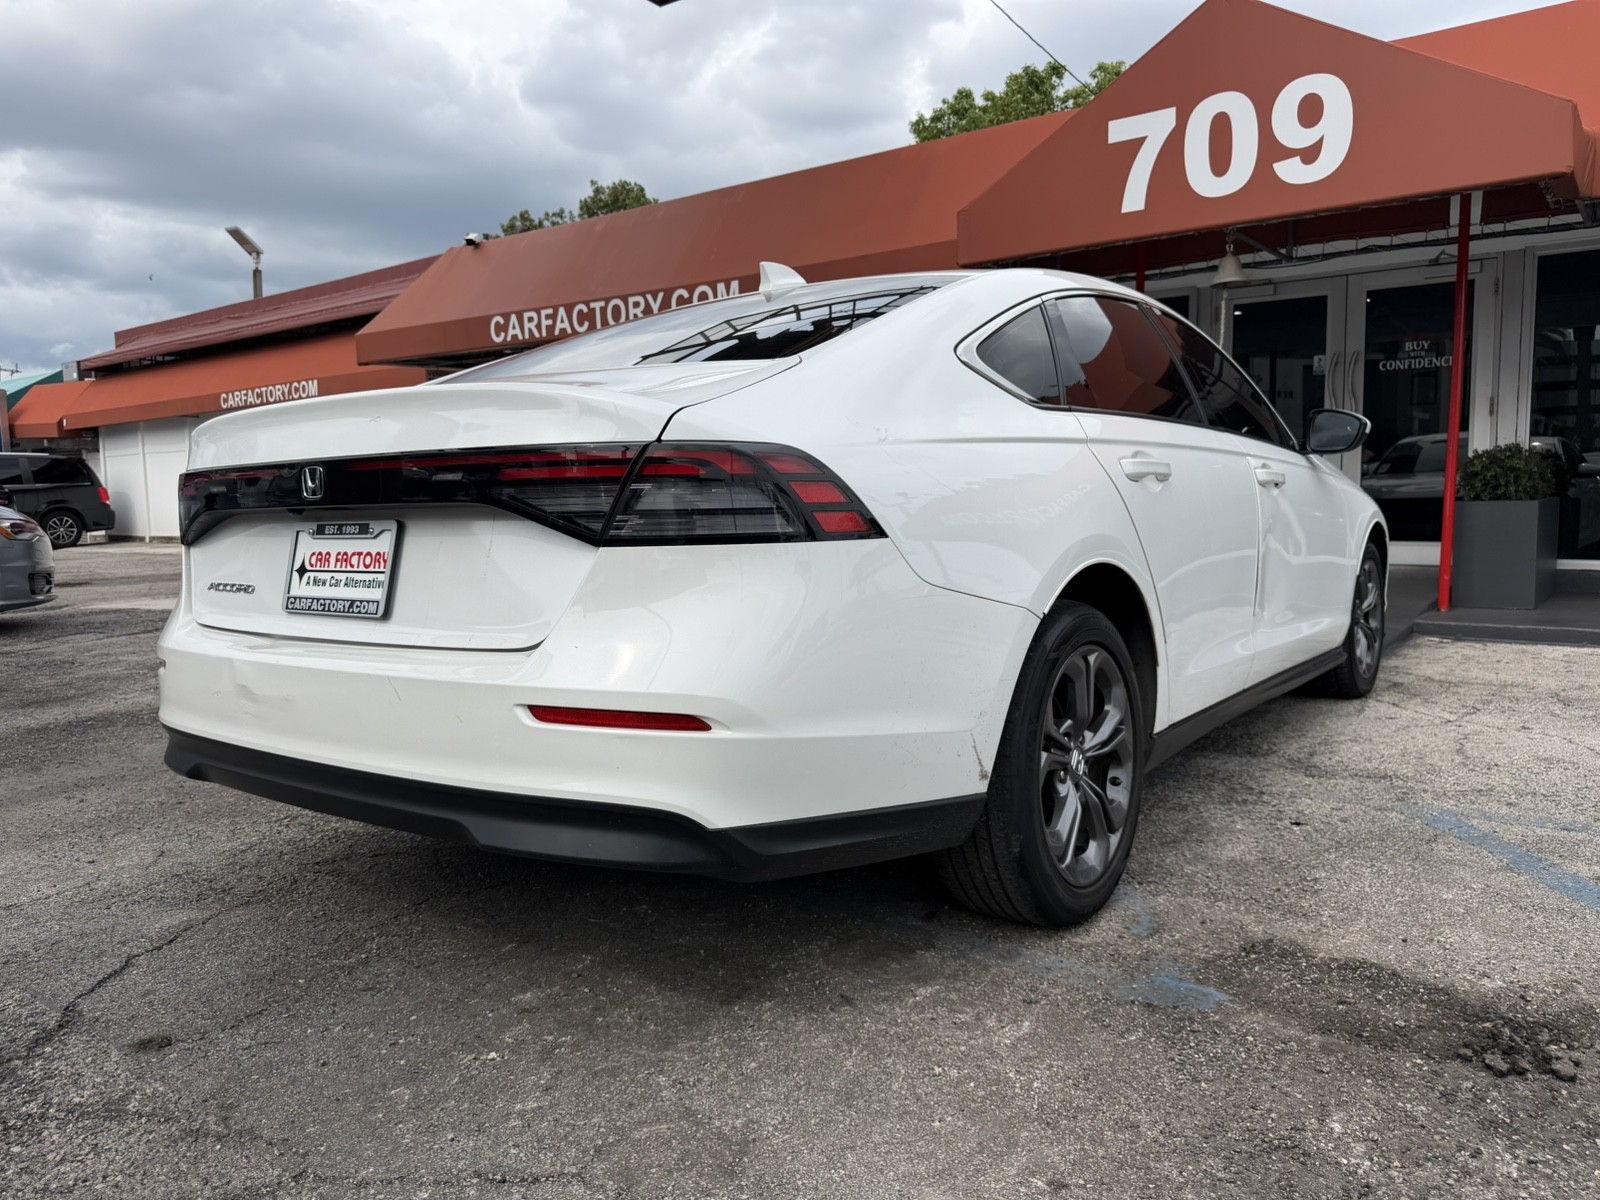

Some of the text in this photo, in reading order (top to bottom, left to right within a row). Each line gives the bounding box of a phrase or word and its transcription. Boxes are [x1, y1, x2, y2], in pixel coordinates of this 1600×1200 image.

[1107, 73, 1354, 214] 709
[490, 279, 740, 344] CARFACTORYCOM
[1405, 341, 1431, 351] BUY
[220, 379, 319, 409] CARFACTORY.COM
[325, 525, 359, 534] EST. 1993
[308, 551, 388, 569] CAR FACTORY
[207, 582, 256, 594] ACCORD
[305, 575, 311, 587] A
[312, 576, 328, 588] New
[328, 575, 342, 588] Car
[287, 597, 378, 614] CARFACTORY.COM
